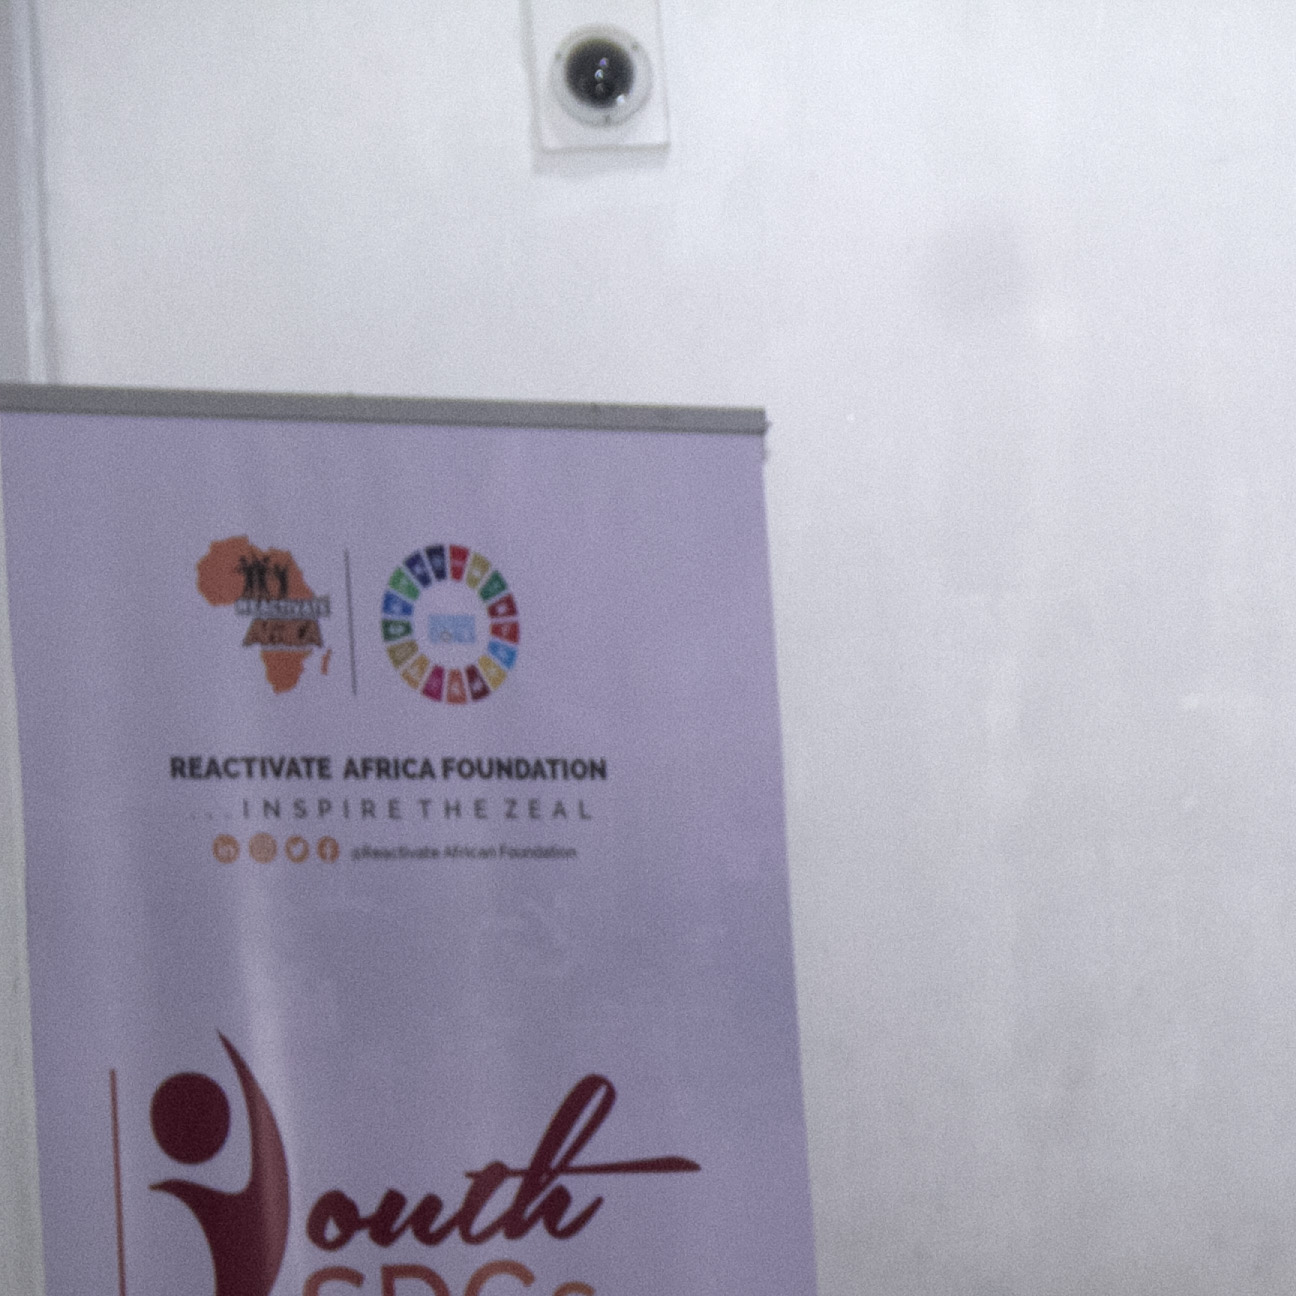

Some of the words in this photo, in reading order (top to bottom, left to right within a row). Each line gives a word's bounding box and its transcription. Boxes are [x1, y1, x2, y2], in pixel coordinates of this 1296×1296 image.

[169, 755, 332, 781] REACTIVATE
[343, 756, 437, 780] AFRICA
[441, 756, 608, 781] FOUNDATION
